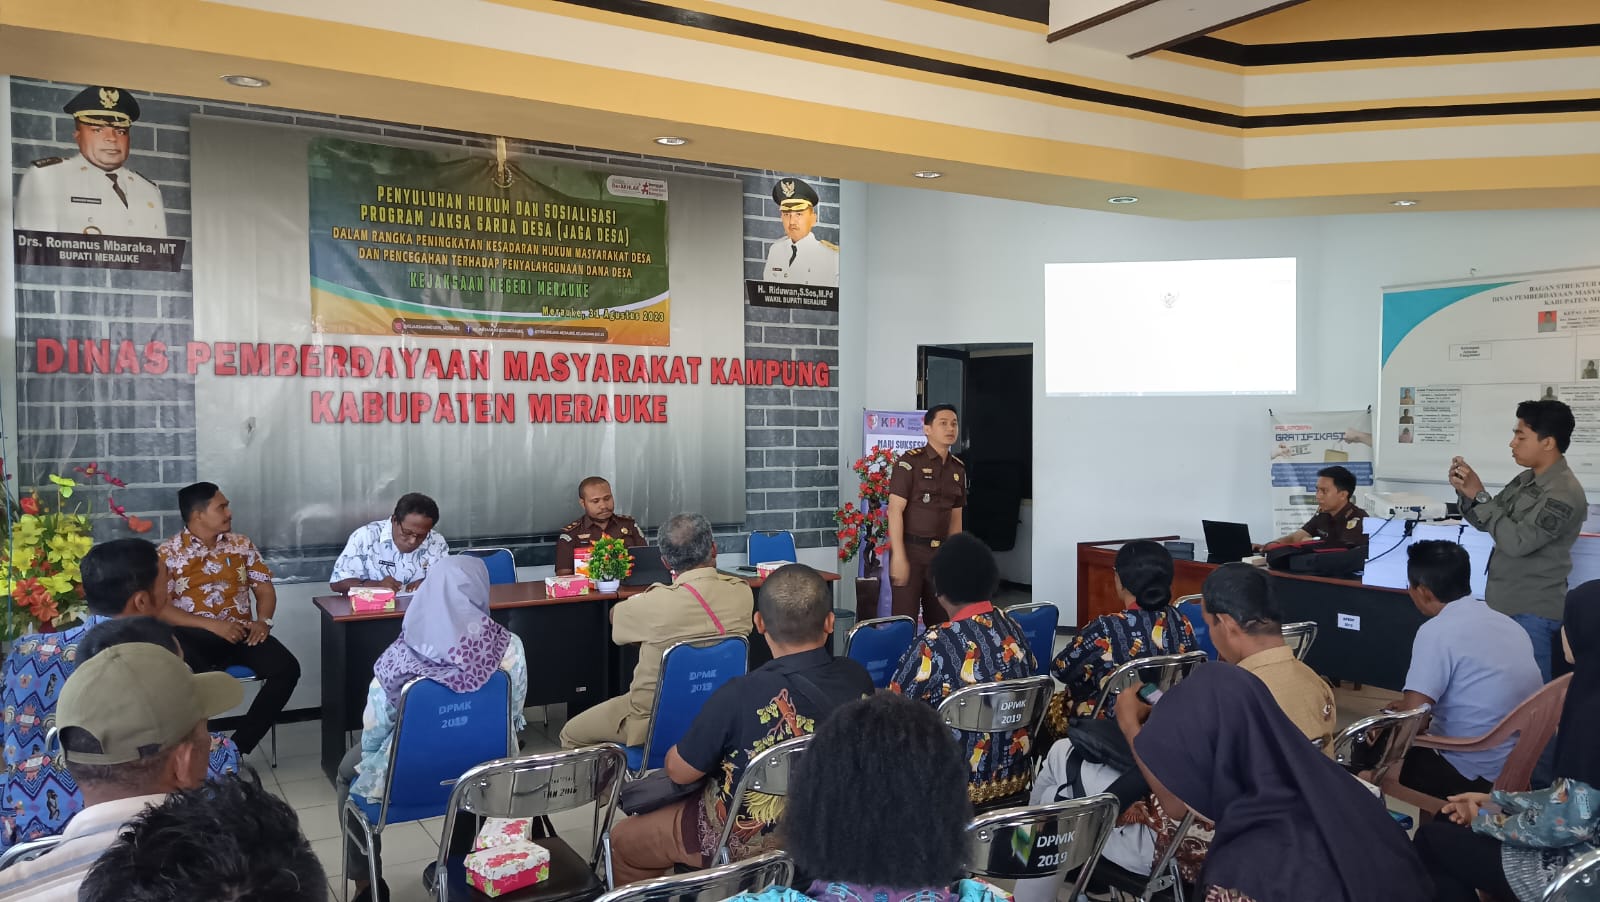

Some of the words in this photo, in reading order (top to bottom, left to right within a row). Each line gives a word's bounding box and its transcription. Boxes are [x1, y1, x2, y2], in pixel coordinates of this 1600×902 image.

[377, 185, 462, 210] PENYULUHAN
[468, 195, 510, 214] HUKUM
[516, 200, 539, 218] DAN
[544, 204, 616, 225] SOSIALISASI
[360, 204, 424, 226] PROGRAM
[430, 211, 471, 231] JAKSA
[476, 216, 517, 235] GARDA
[522, 220, 552, 238] DESA
[557, 220, 592, 241] (JAGA
[597, 226, 630, 247] DESA)
[18, 235, 42, 247] Drs.
[46, 237, 100, 250] Romanus
[103, 240, 156, 255] Mbaraka,
[159, 243, 177, 254] MT
[332, 226, 368, 241] DALAM
[371, 230, 413, 245] RANGKA
[416, 234, 483, 251] PENINGKATAN
[486, 240, 539, 255] KESADARAN
[541, 246, 572, 258] HUKUM
[575, 247, 629, 263] MASYARAKAT
[631, 252, 651, 264] DESA
[59, 250, 92, 261] BUPATI
[95, 252, 139, 263] MERAUKE
[358, 247, 380, 260] DAN
[383, 249, 448, 265] PENCEGAHAN
[451, 254, 499, 269] TERHADAP
[502, 259, 584, 275] PENYALAHGUNAAN
[586, 266, 610, 277] DANA
[612, 267, 632, 279] DESA
[409, 272, 483, 293] KEJAKSAAN
[489, 276, 532, 295] NEGERI
[536, 280, 589, 298] MERAUKE
[758, 285, 766, 293] H.
[1529, 284, 1554, 292] BAGAN
[1556, 281, 1597, 289] STRUKTUR
[765, 295, 782, 303] WAKIL
[783, 296, 802, 304] BUPATI
[803, 298, 828, 306] MERAUKE
[1492, 295, 1513, 303] DINAS
[1514, 290, 1573, 301] PEMBERDAYAAN
[1544, 297, 1588, 305] KABUPATEN
[542, 306, 586, 320] Merauke,
[589, 309, 600, 318] 31
[603, 310, 640, 321] Agustus
[642, 311, 665, 322] 2023
[35, 338, 169, 375] DINAS
[187, 341, 490, 381] PEMBERDAYAAN
[503, 350, 701, 385] MASYARAKAT
[710, 356, 830, 388] KAMPUNG
[311, 390, 515, 424] KABUPATEN
[528, 393, 668, 424] MERAUKE
[881, 417, 905, 428] KPK
[1275, 431, 1346, 442] GRATIFIKASI
[878, 440, 895, 449] MARI
[689, 669, 717, 681] DPMK
[438, 701, 472, 715] DPMK
[1000, 700, 1026, 711] DPMK
[440, 716, 468, 728] 2019
[1001, 714, 1022, 724] 2019
[1036, 830, 1077, 848] DPMK
[1037, 851, 1068, 868] 2019
